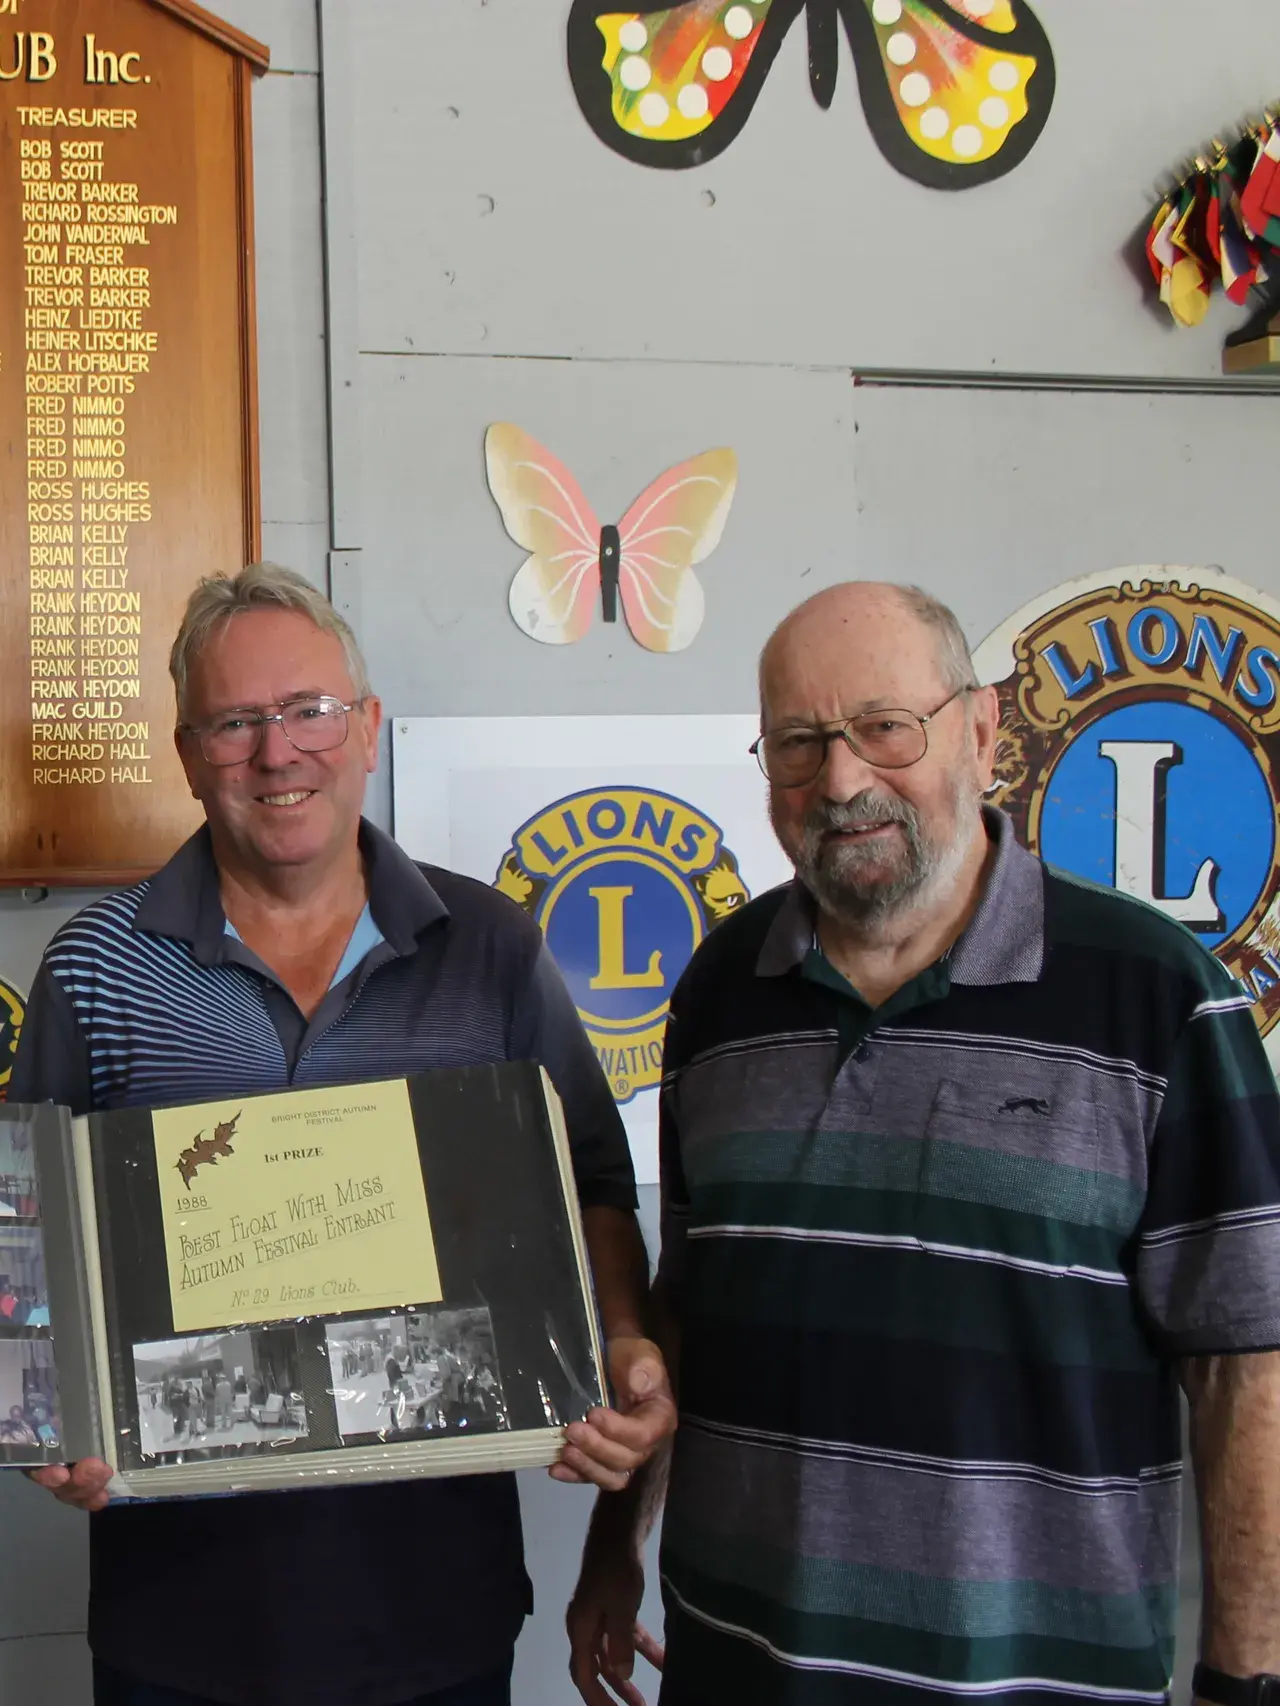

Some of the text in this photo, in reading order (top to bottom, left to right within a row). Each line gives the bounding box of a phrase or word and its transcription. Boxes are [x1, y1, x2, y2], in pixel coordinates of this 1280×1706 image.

[82, 33, 152, 85] Inc.
[16, 106, 137, 128] TREASURER
[20, 139, 104, 160] BOB SCOTT
[22, 181, 139, 203] TREVOR BARKER
[22, 202, 177, 224] RICHARD ROSSINGTON
[23, 223, 150, 245] JOHN VANDERWAL
[24, 244, 123, 264] TOM FRASER
[25, 308, 142, 330] HEINZ LIEDTKE
[26, 331, 158, 351] HEINER LITSCHKE
[26, 352, 149, 372] ALEX HOFBAUER
[26, 374, 134, 393] ROBERT POTTS
[27, 396, 124, 415] FRED NIMMO
[28, 481, 150, 500] ROSS HUGHES
[30, 525, 128, 543] BRIAN KELLY
[31, 592, 140, 613] FRANK HEYDON
[1040, 606, 1280, 708] LIONS
[32, 701, 123, 719] MAC GUILD
[33, 722, 148, 741] FRANK HEYDON
[33, 743, 150, 760] RICHARD HALL
[34, 766, 152, 784] RICHARD HALL
[530, 799, 707, 866] LIONS
[1099, 741, 1224, 932] L
[588, 886, 665, 990] L
[342, 1104, 377, 1115] AUTUMN
[264, 1146, 324, 1163] 1st PRIZE
[177, 1196, 208, 1211] 1988
[280, 1285, 315, 1302] Lions
